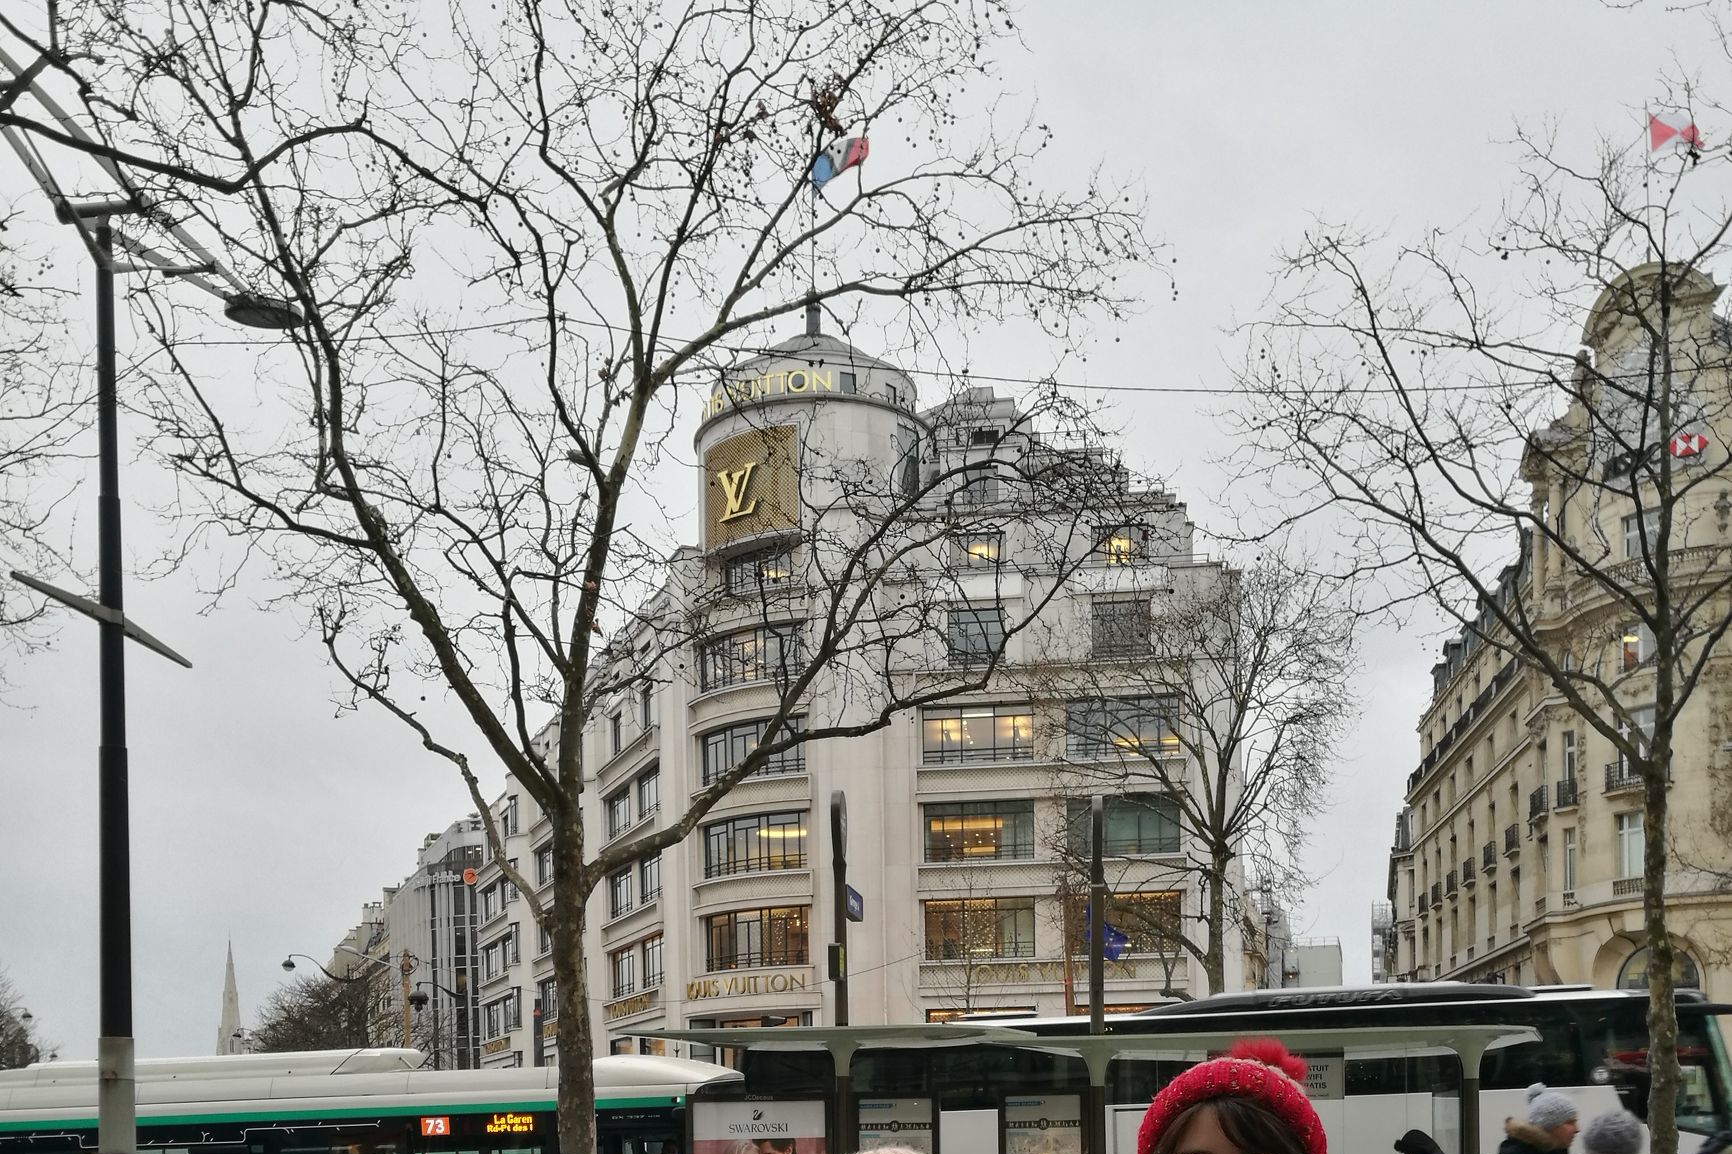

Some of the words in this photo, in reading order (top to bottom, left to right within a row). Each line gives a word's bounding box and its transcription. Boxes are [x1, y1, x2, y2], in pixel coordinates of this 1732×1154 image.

[686, 979, 720, 1001] LOUIS
[723, 973, 806, 996] VUITTON
[493, 1114, 506, 1125] La
[425, 1119, 445, 1135] 73
[512, 1123, 528, 1132] des
[728, 1122, 789, 1134] SWAROVSKI
